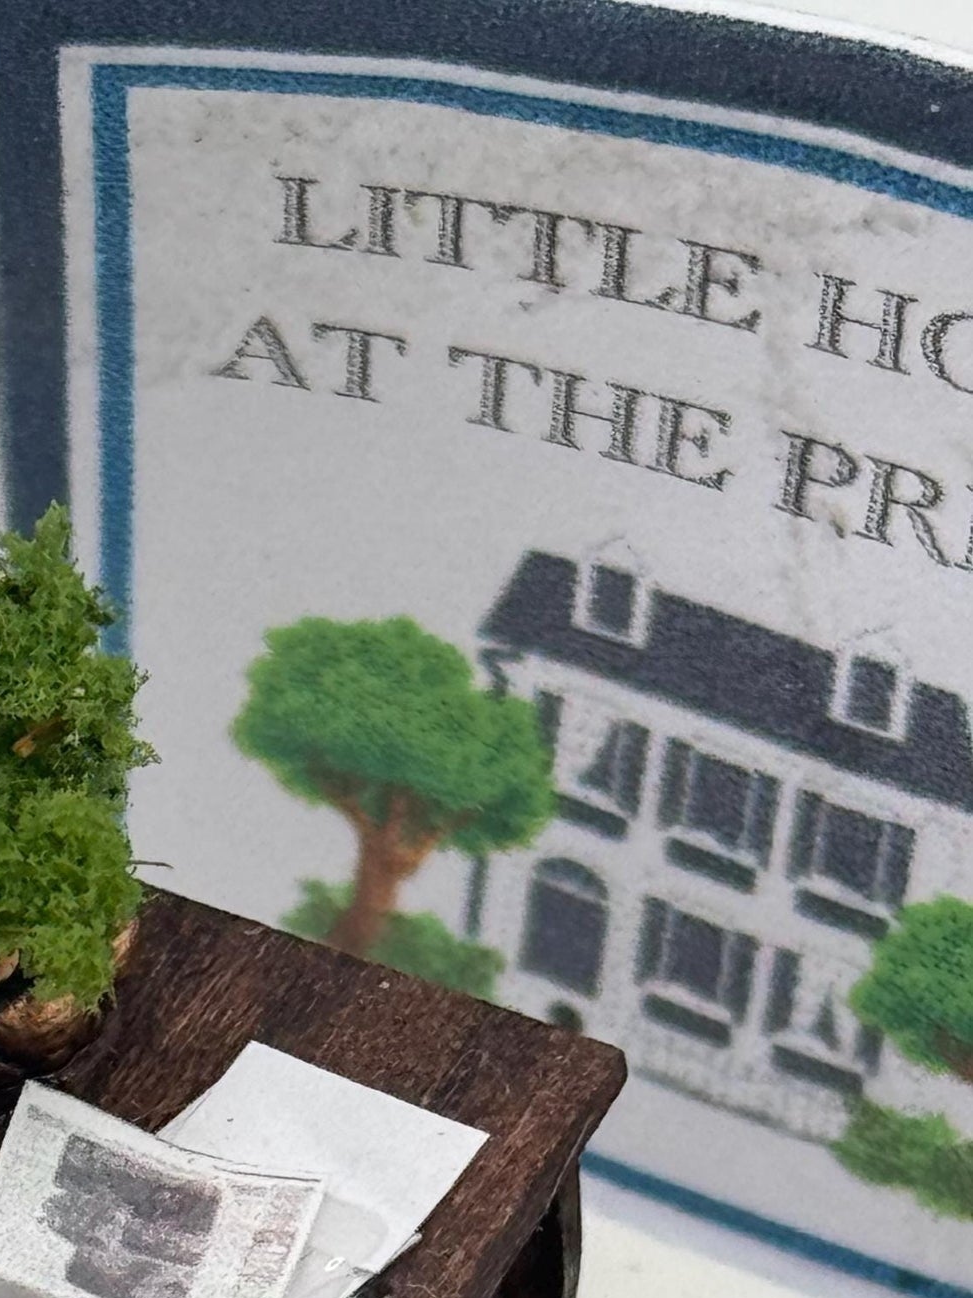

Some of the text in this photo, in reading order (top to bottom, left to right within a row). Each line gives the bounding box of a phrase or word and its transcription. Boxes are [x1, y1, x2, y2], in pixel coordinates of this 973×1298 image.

[273, 176, 762, 332] LITTLE
[211, 316, 973, 572] AT THE PR
